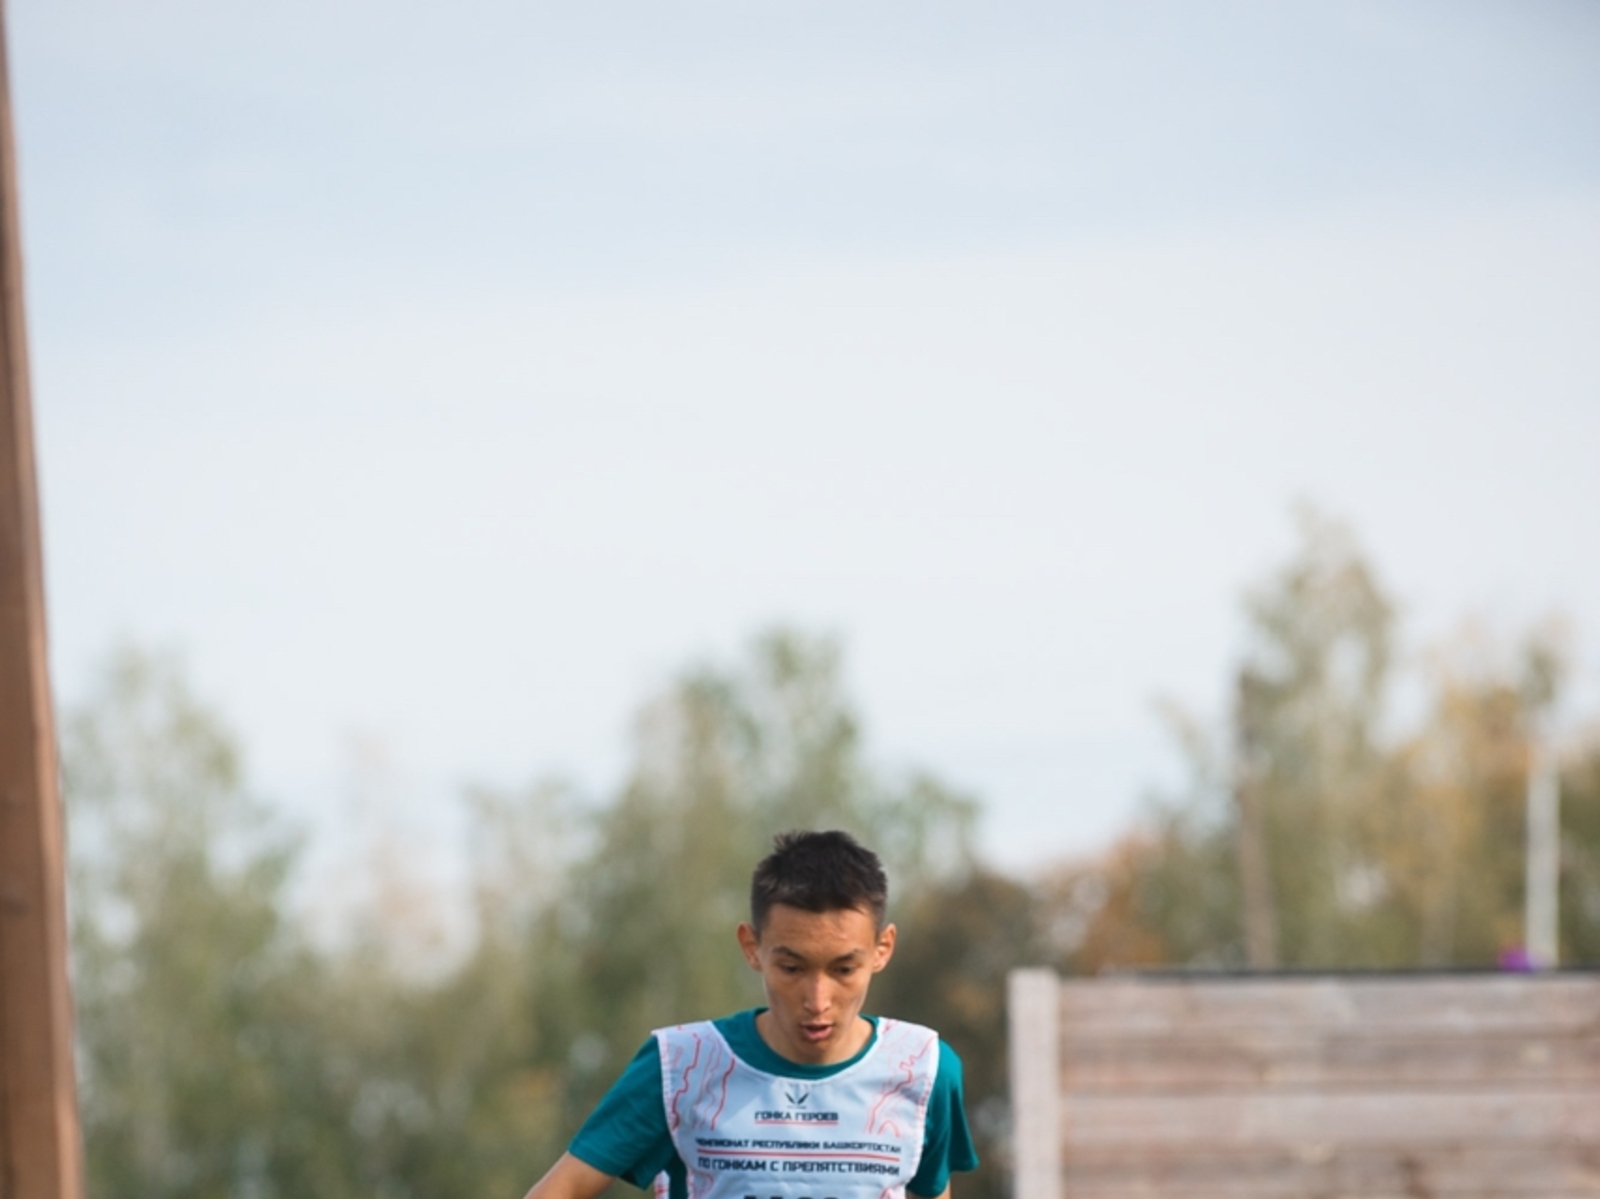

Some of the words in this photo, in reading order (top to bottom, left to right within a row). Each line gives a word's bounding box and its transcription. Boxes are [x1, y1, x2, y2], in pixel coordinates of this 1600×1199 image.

[755, 1111, 792, 1121] ГОНКА
[795, 1112, 839, 1121] ГЕРОЕВ
[752, 1140, 820, 1149] РЕСПУБЛИКИ
[823, 1141, 901, 1153] БАШКОРТОСТАН
[698, 1156, 710, 1169] ПО
[712, 1159, 766, 1171] ГОНКАМ
[769, 1161, 779, 1171] С
[782, 1161, 900, 1175] ПРЕПЯТСТВИЯМИ
